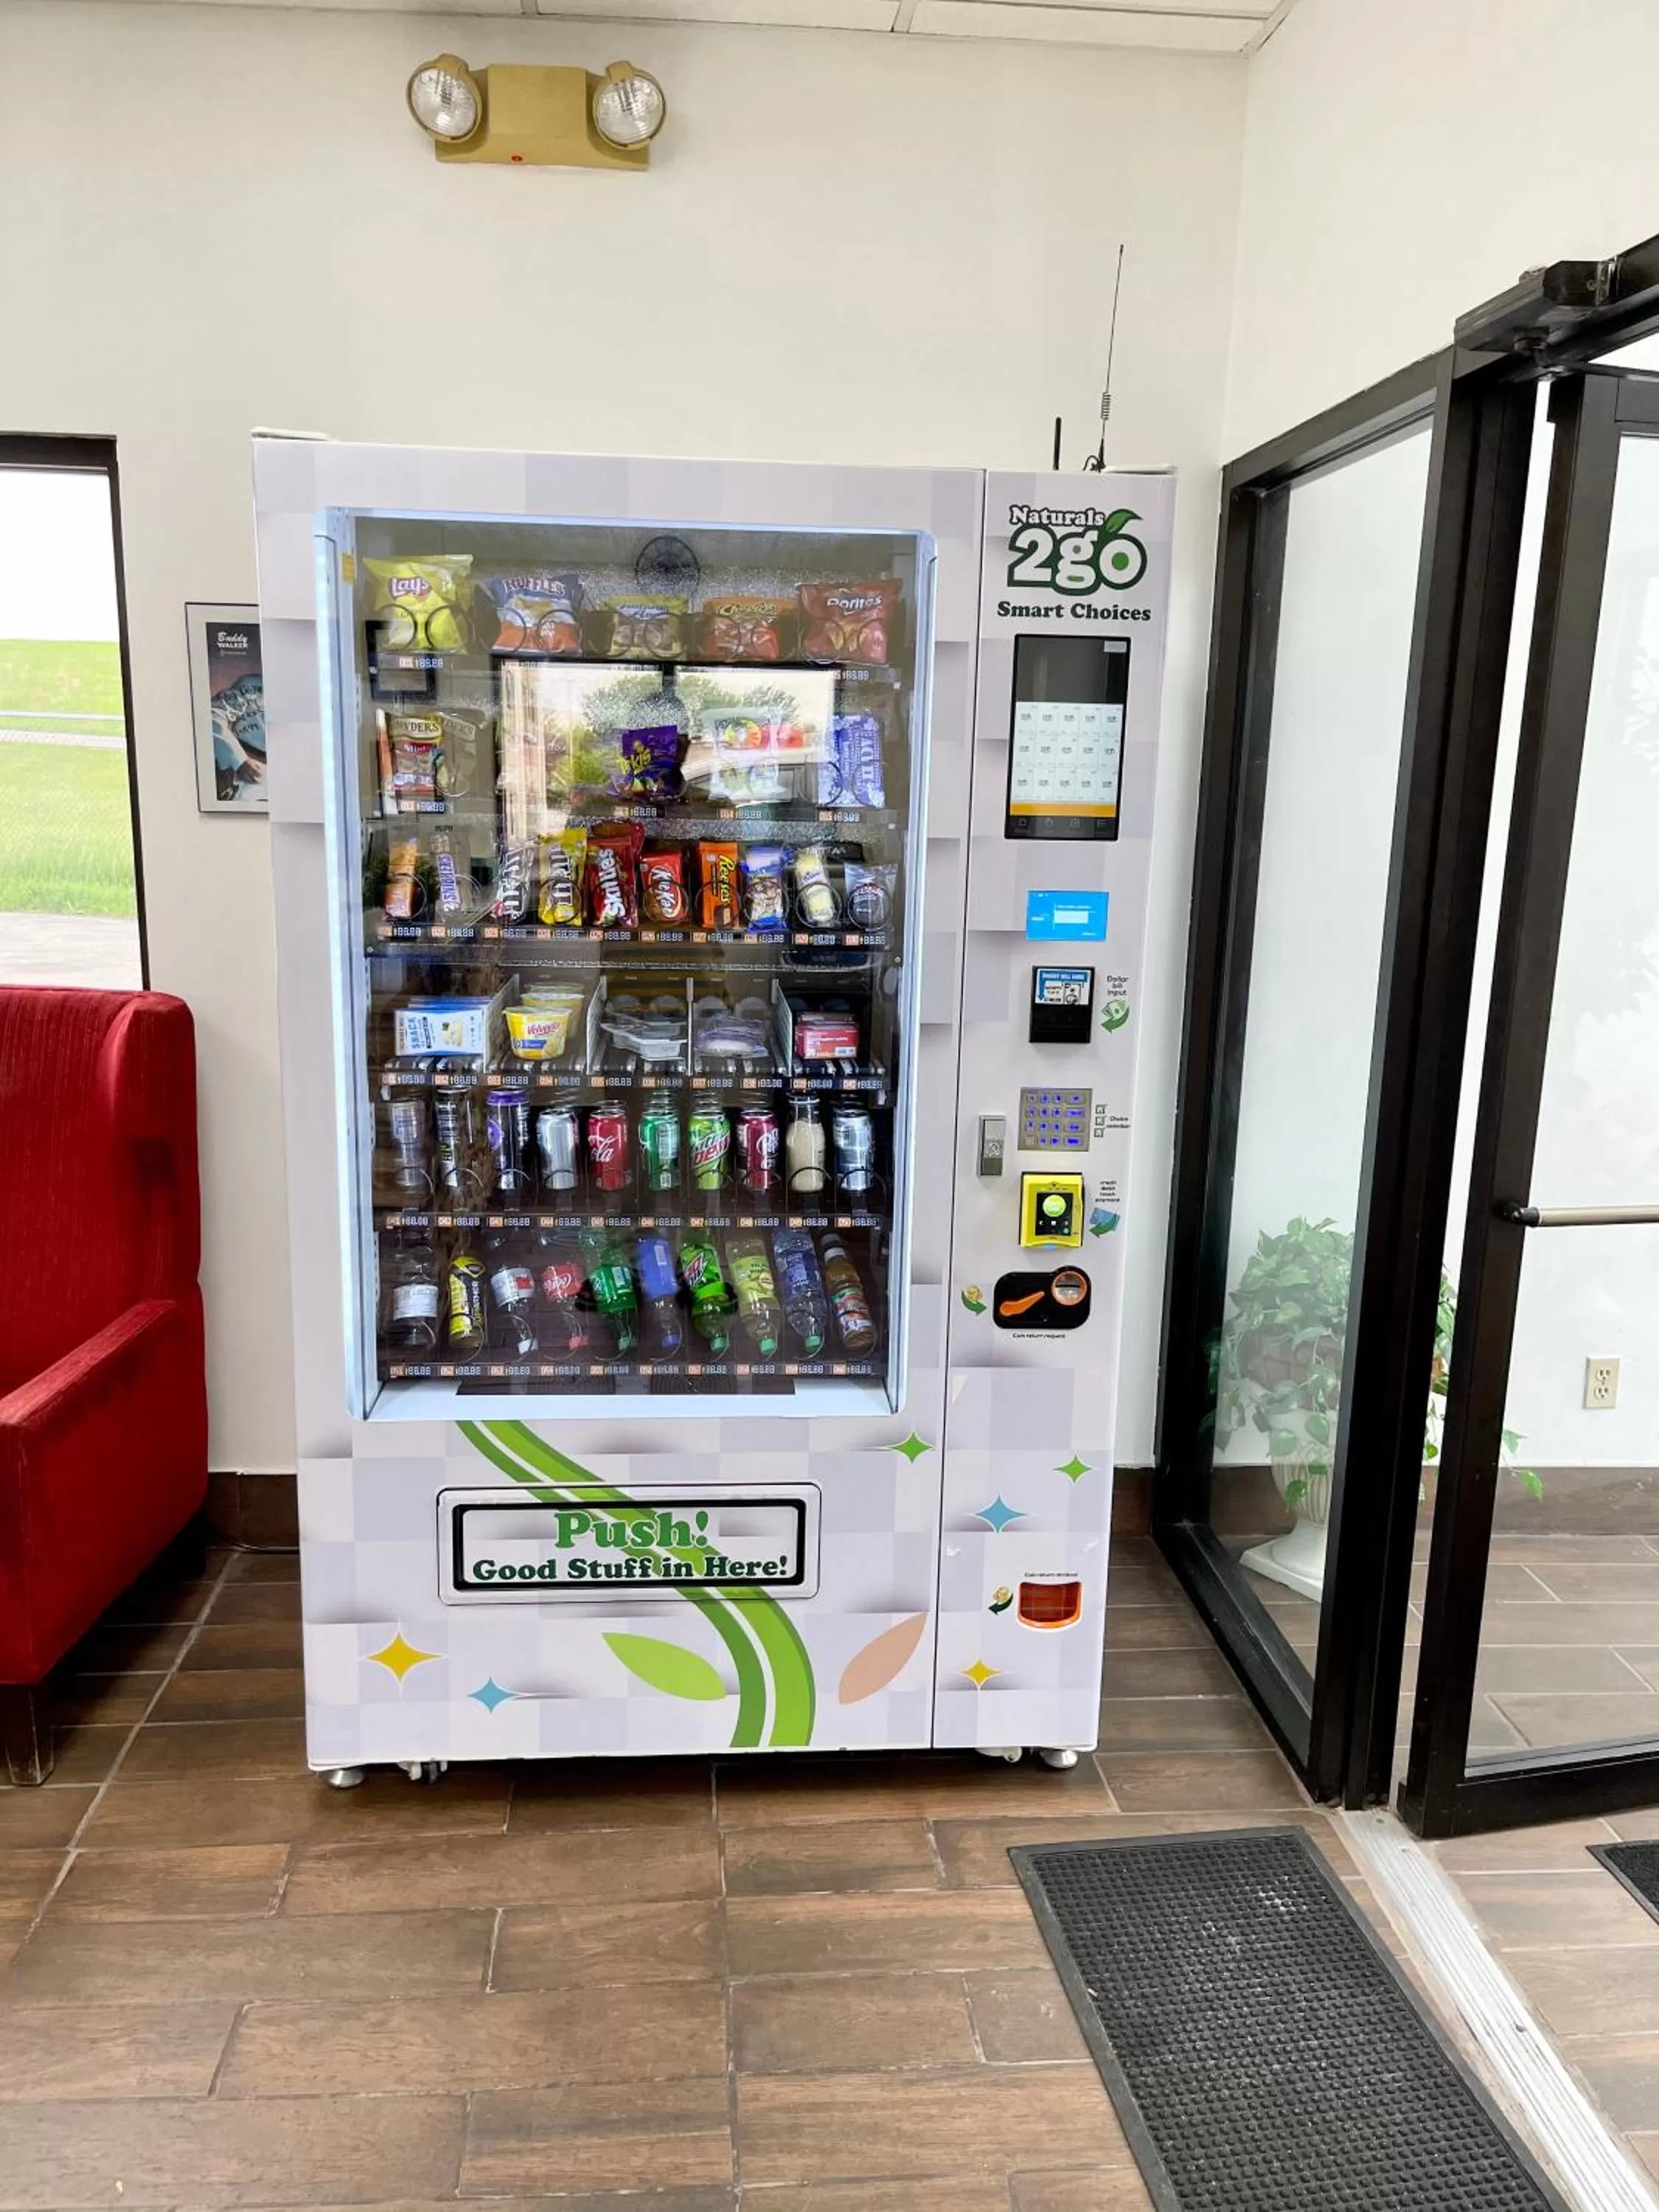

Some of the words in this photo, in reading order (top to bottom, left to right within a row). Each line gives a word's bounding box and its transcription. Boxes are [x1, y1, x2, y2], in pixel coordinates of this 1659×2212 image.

[1009, 504, 1106, 526] Naturals
[1007, 524, 1147, 597] 2go
[997, 601, 1064, 618] Smart
[1070, 603, 1152, 621] Choices
[554, 1510, 709, 1548] Push!
[472, 1559, 557, 1582] Good
[567, 1557, 653, 1579] Stuff
[661, 1557, 695, 1579] in
[703, 1555, 788, 1578] Here!
